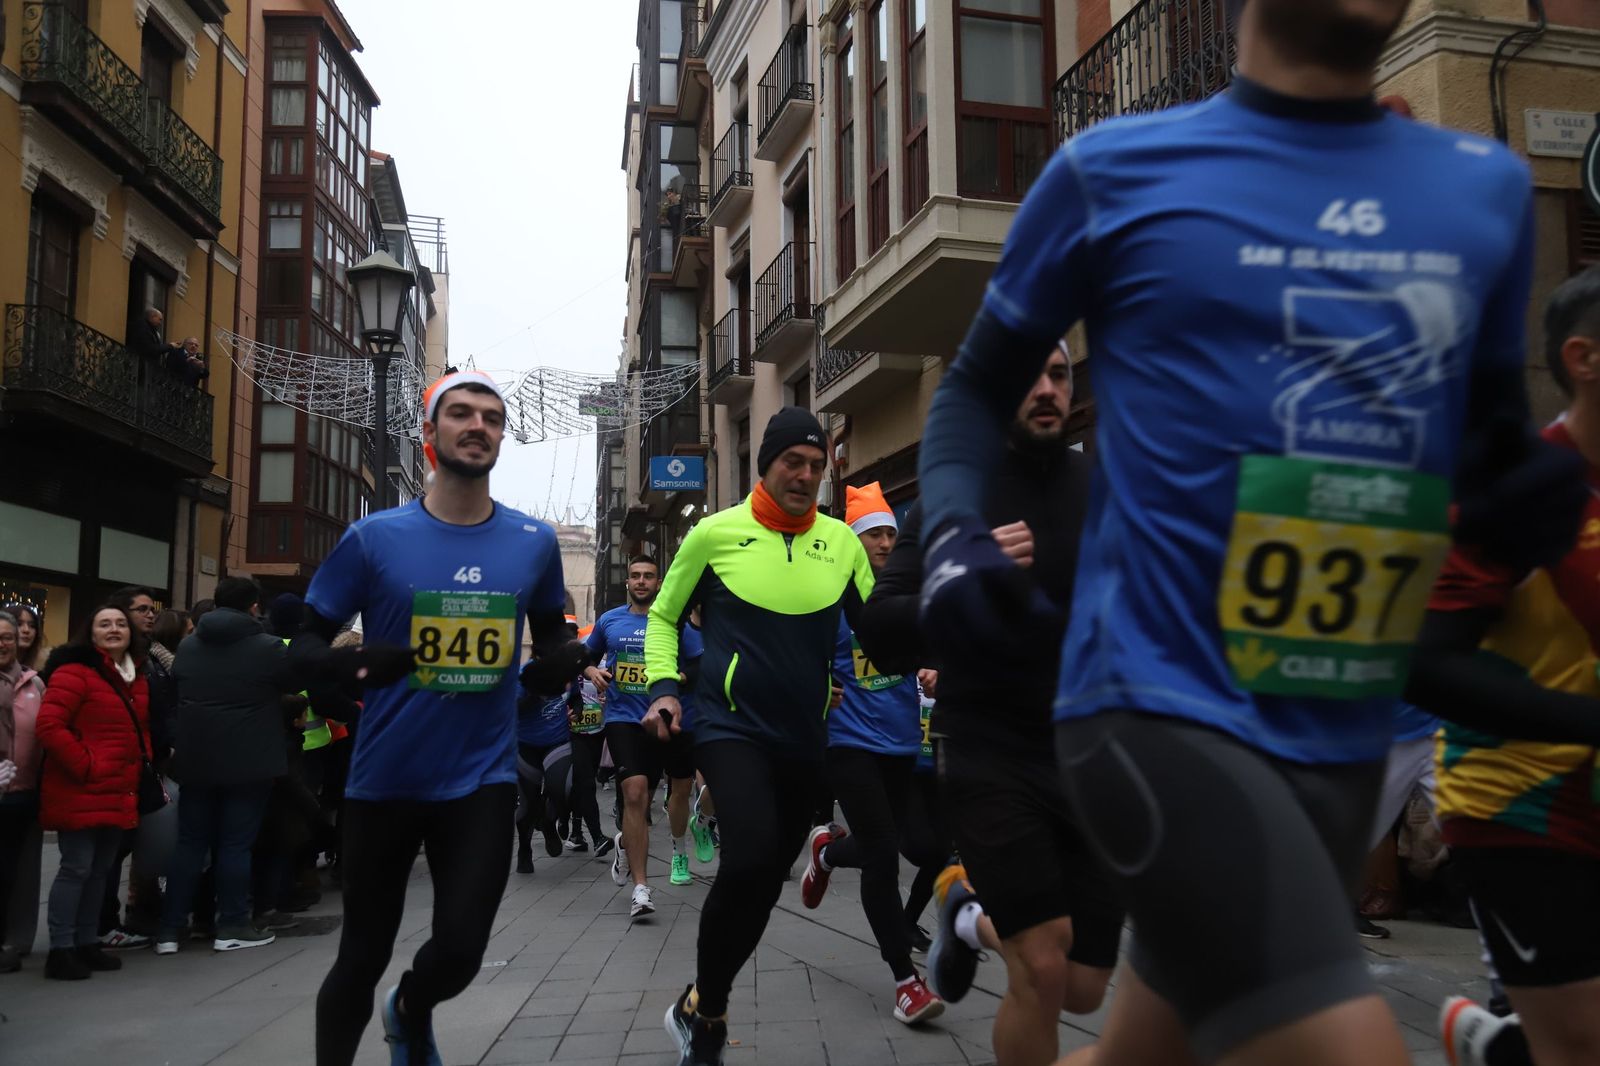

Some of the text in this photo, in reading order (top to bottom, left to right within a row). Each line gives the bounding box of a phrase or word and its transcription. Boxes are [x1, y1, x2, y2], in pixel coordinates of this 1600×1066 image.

[1553, 116, 1586, 128] CALLE
[1561, 129, 1575, 139] DE
[1316, 199, 1386, 236] 46
[1239, 245, 1285, 266] SAN
[653, 479, 701, 488] Samsonite
[453, 566, 482, 584] 46
[1240, 539, 1421, 639] 937
[633, 628, 646, 636] 46
[417, 626, 500, 665] 846
[438, 673, 467, 685] CAJA
[618, 665, 649, 684] 753
